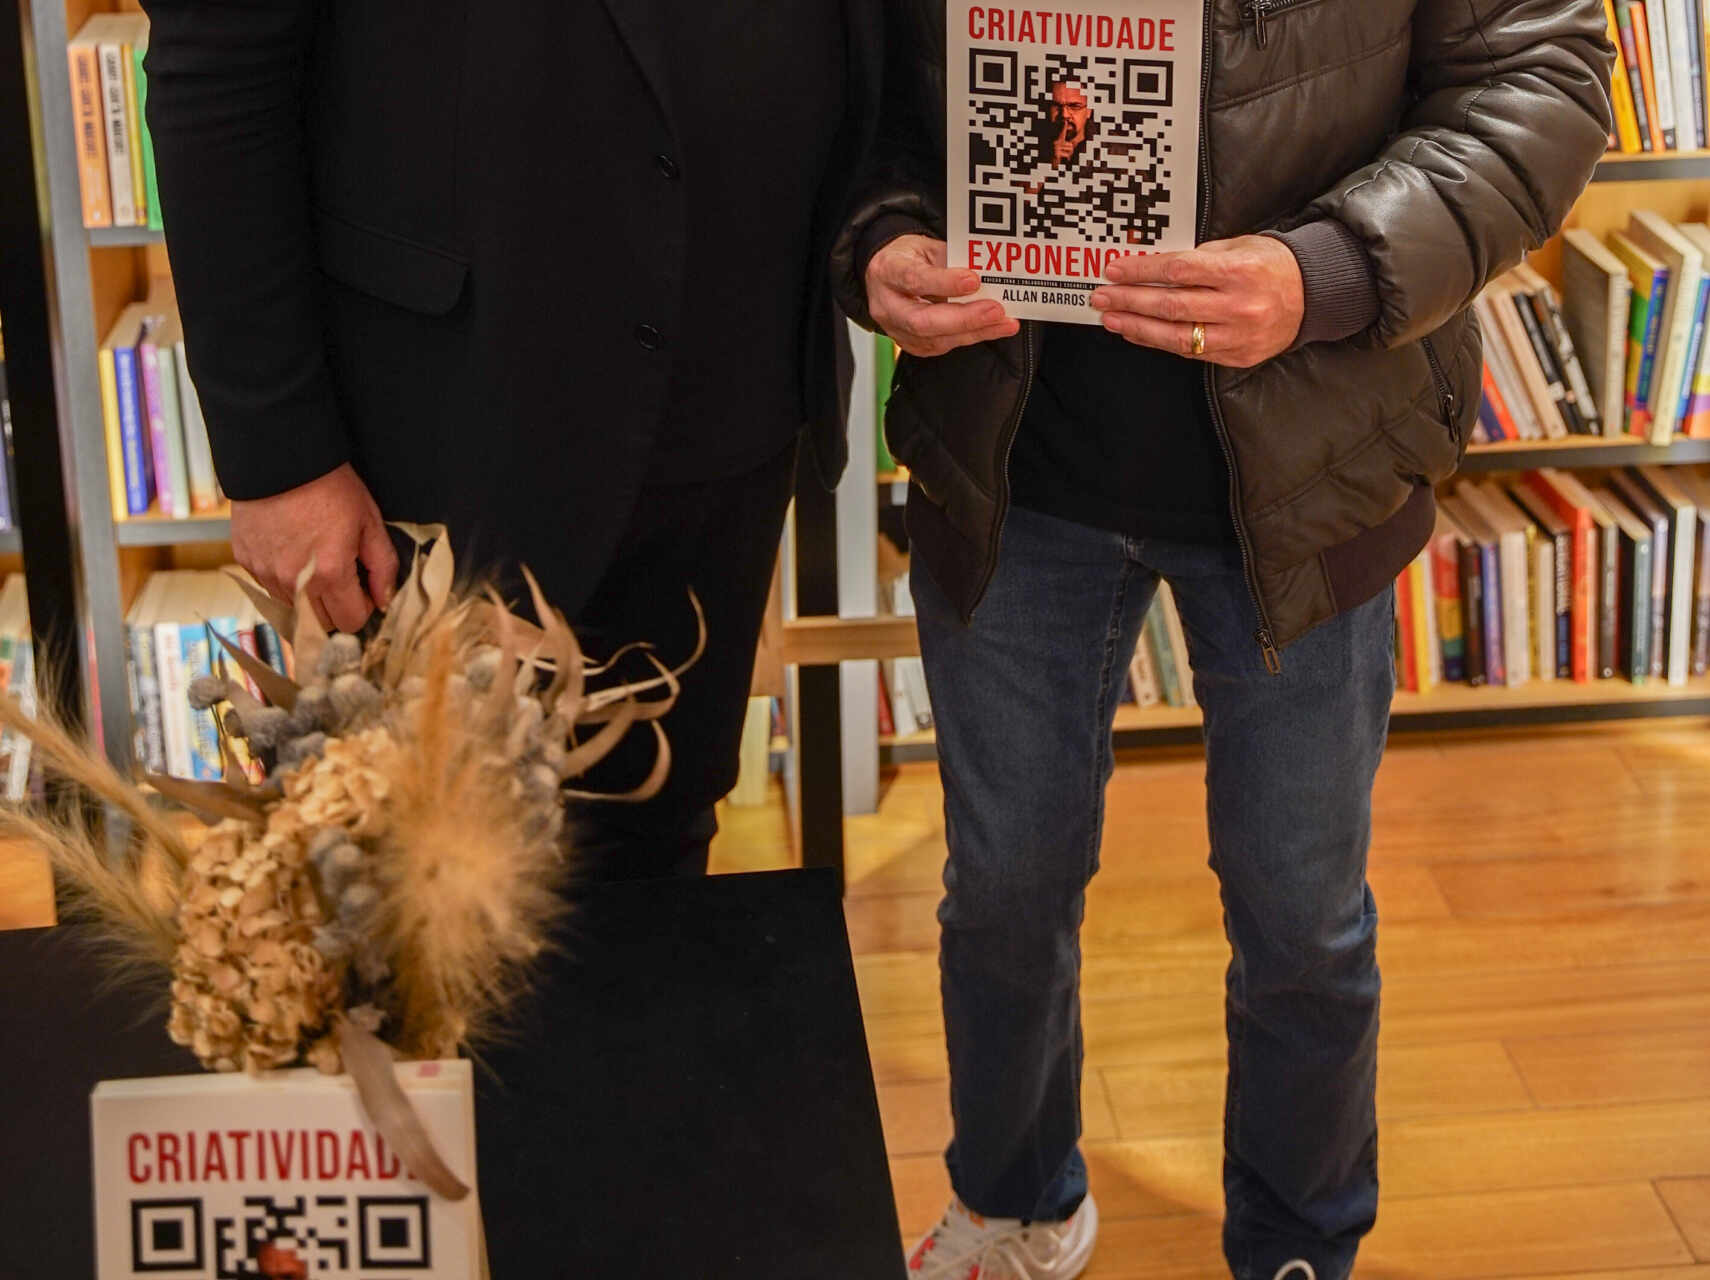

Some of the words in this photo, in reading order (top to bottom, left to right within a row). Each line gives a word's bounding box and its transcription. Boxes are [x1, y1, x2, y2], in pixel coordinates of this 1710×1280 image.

[969, 6, 1175, 51] CRIATIVIDADE
[969, 240, 1161, 278] EXPONEN
[1003, 288, 1037, 304] ALLAN
[1041, 291, 1086, 307] BARROS
[127, 1129, 418, 1184] CRIATIVIDAD
